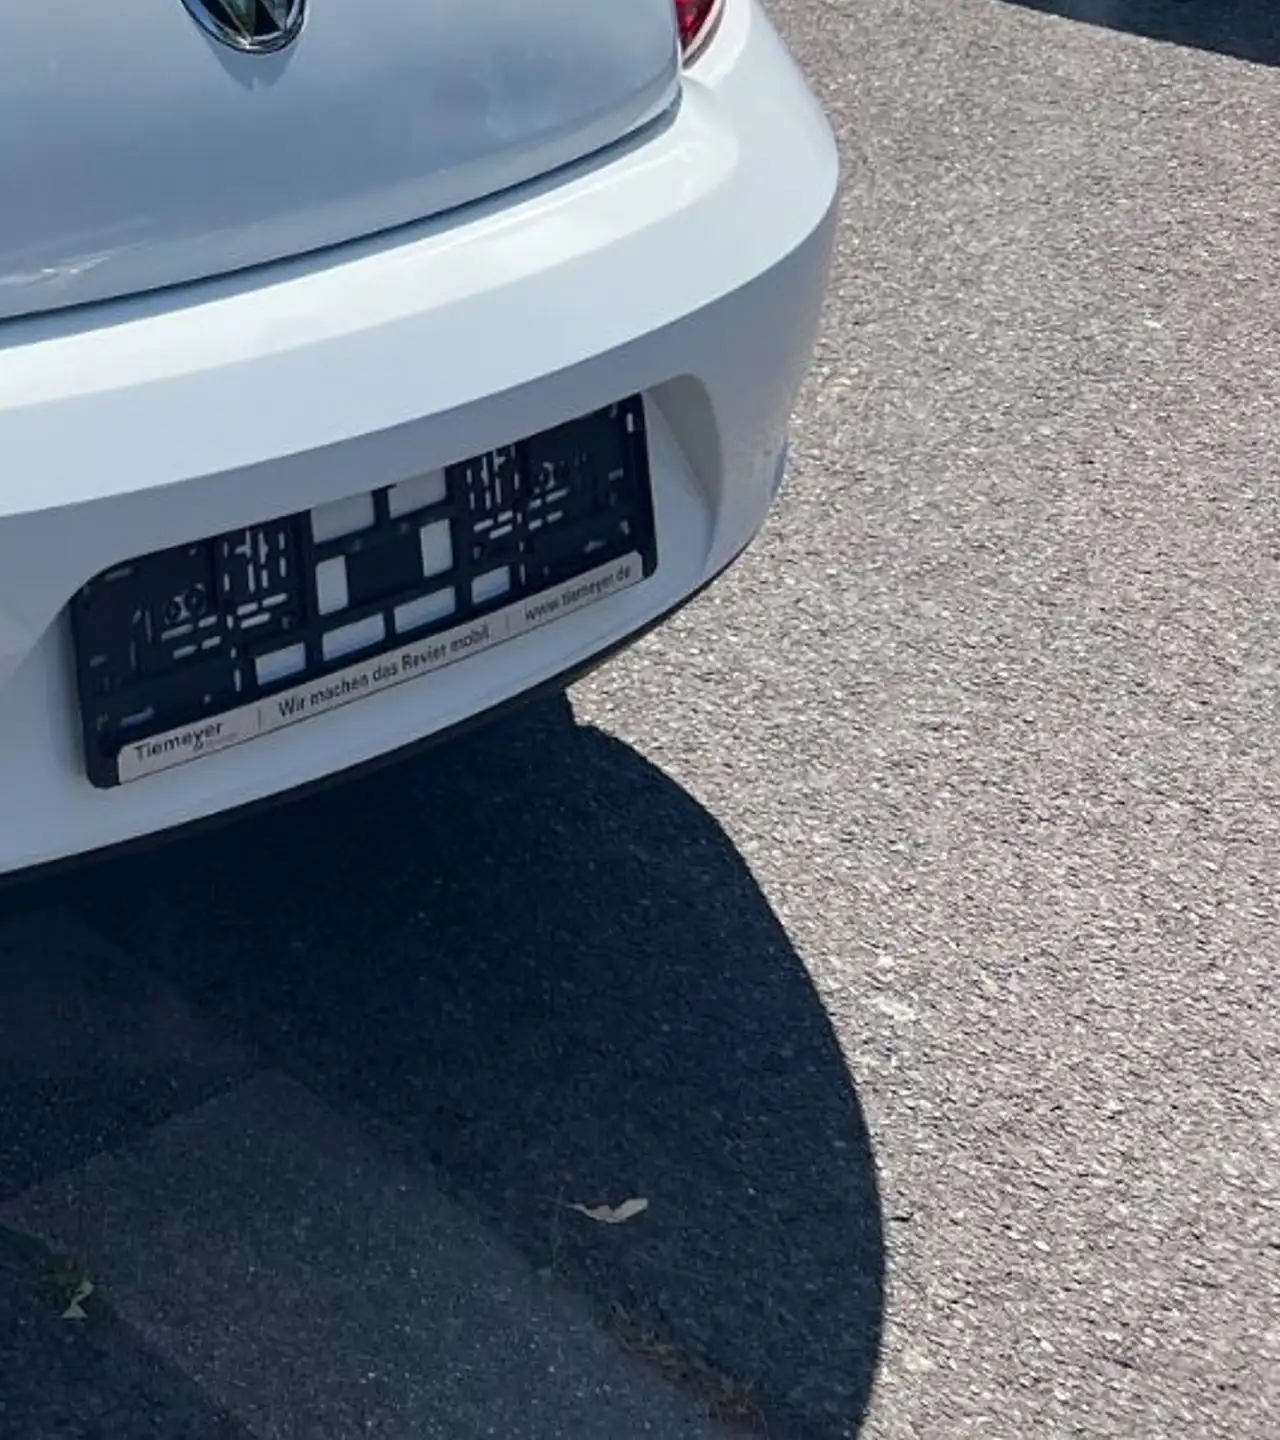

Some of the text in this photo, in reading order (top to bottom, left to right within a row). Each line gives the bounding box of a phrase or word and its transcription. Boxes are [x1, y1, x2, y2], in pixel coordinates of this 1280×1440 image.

[134, 721, 224, 761] Tiemeyer
[278, 699, 306, 718] Wir
[310, 673, 369, 706] machen
[372, 663, 398, 684] das
[402, 645, 447, 671] Revier
[450, 624, 490, 651] mobil
